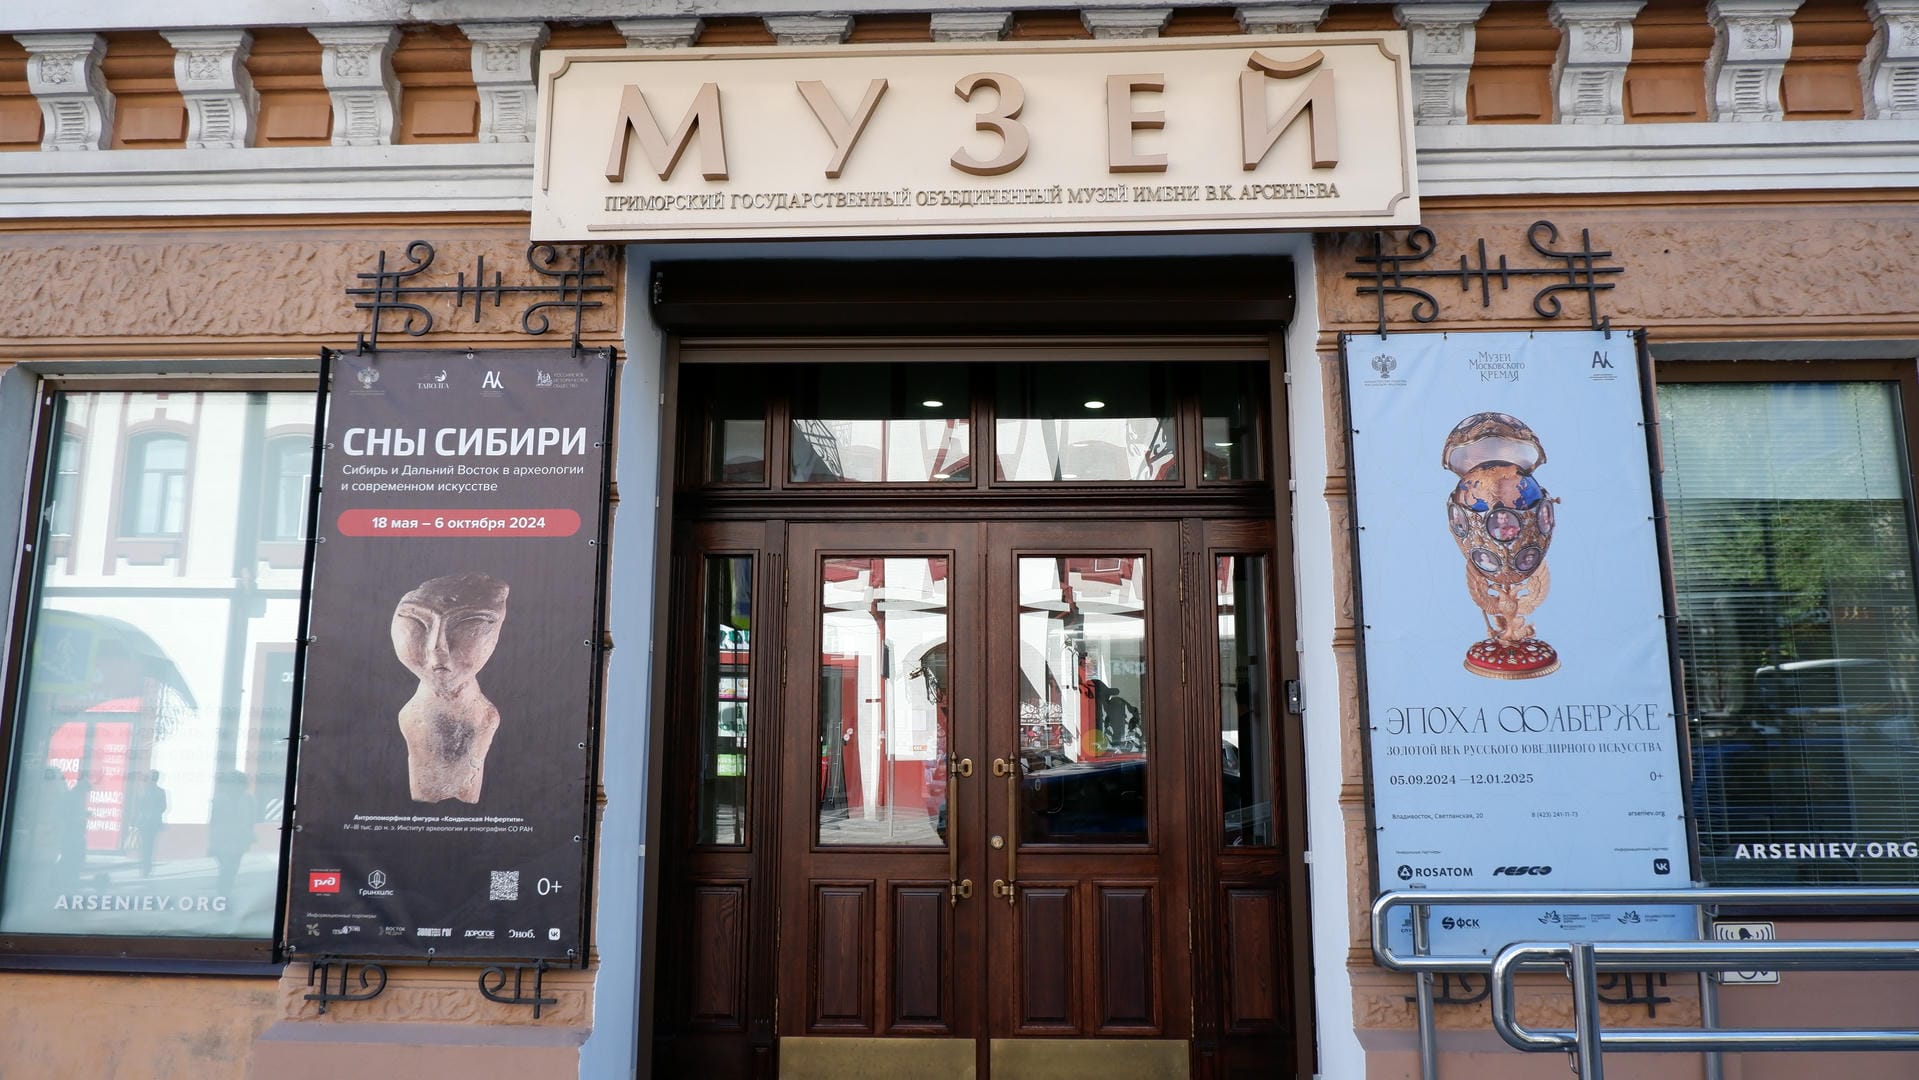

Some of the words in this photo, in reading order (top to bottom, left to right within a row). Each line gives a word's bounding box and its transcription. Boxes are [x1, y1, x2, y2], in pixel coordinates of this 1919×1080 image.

[605, 49, 1340, 183] МУЗЕЙ
[604, 192, 725, 212] ПРИМОРСКИЙ
[730, 188, 911, 211] ГОСУДАРСТВЕННЫЙ
[915, 185, 1063, 209] ОБЪЕДИНЕННЫЙ
[1067, 184, 1128, 204] МУЗЕЙ
[1133, 185, 1200, 202] ИМЕНИ
[1239, 182, 1341, 200] АРСЕНЬЕВА
[343, 427, 426, 457] СНЫ
[435, 427, 587, 456] СИБИРИ
[342, 464, 388, 475] Сибирь
[392, 466, 399, 475] и
[402, 464, 454, 477] Дальний
[458, 465, 499, 475] Восток
[503, 467, 510, 475] в
[513, 466, 584, 477] археологии
[341, 483, 349, 491] и
[351, 483, 435, 493] современном
[438, 482, 498, 493] искусстве
[372, 517, 387, 528] 18
[391, 519, 418, 529] мая
[435, 517, 444, 529] 6
[448, 517, 505, 531] октября
[509, 517, 545, 529] 2024
[1386, 706, 1488, 735] ЭПОХА
[1498, 704, 1660, 733] ФАБЕРЖЕ
[1386, 743, 1437, 756] ЗОЛОТОЙ
[1440, 745, 1461, 755] ВЕК
[1463, 744, 1519, 755] РУССКОГО
[1521, 743, 1596, 754] ЮВЕЛИРНОГО
[1599, 742, 1663, 754] ИСКУССТВА
[1389, 773, 1456, 785] 05.09.2024
[1650, 771, 1664, 782] 0+
[354, 814, 411, 822] Антропоморфная
[412, 815, 440, 823] фигурка
[397, 824, 425, 832] Институт
[1734, 842, 1919, 859] ARSENIEV.ORG
[1415, 866, 1474, 877] ROSATOM
[1492, 865, 1553, 876] FESCO
[358, 888, 394, 896] Гринхилс
[537, 877, 563, 896] 0+
[54, 894, 227, 912] ARSENIEV.ORG
[1456, 917, 1480, 928] ФСК
[464, 929, 495, 937] ДОРОГОЕ
